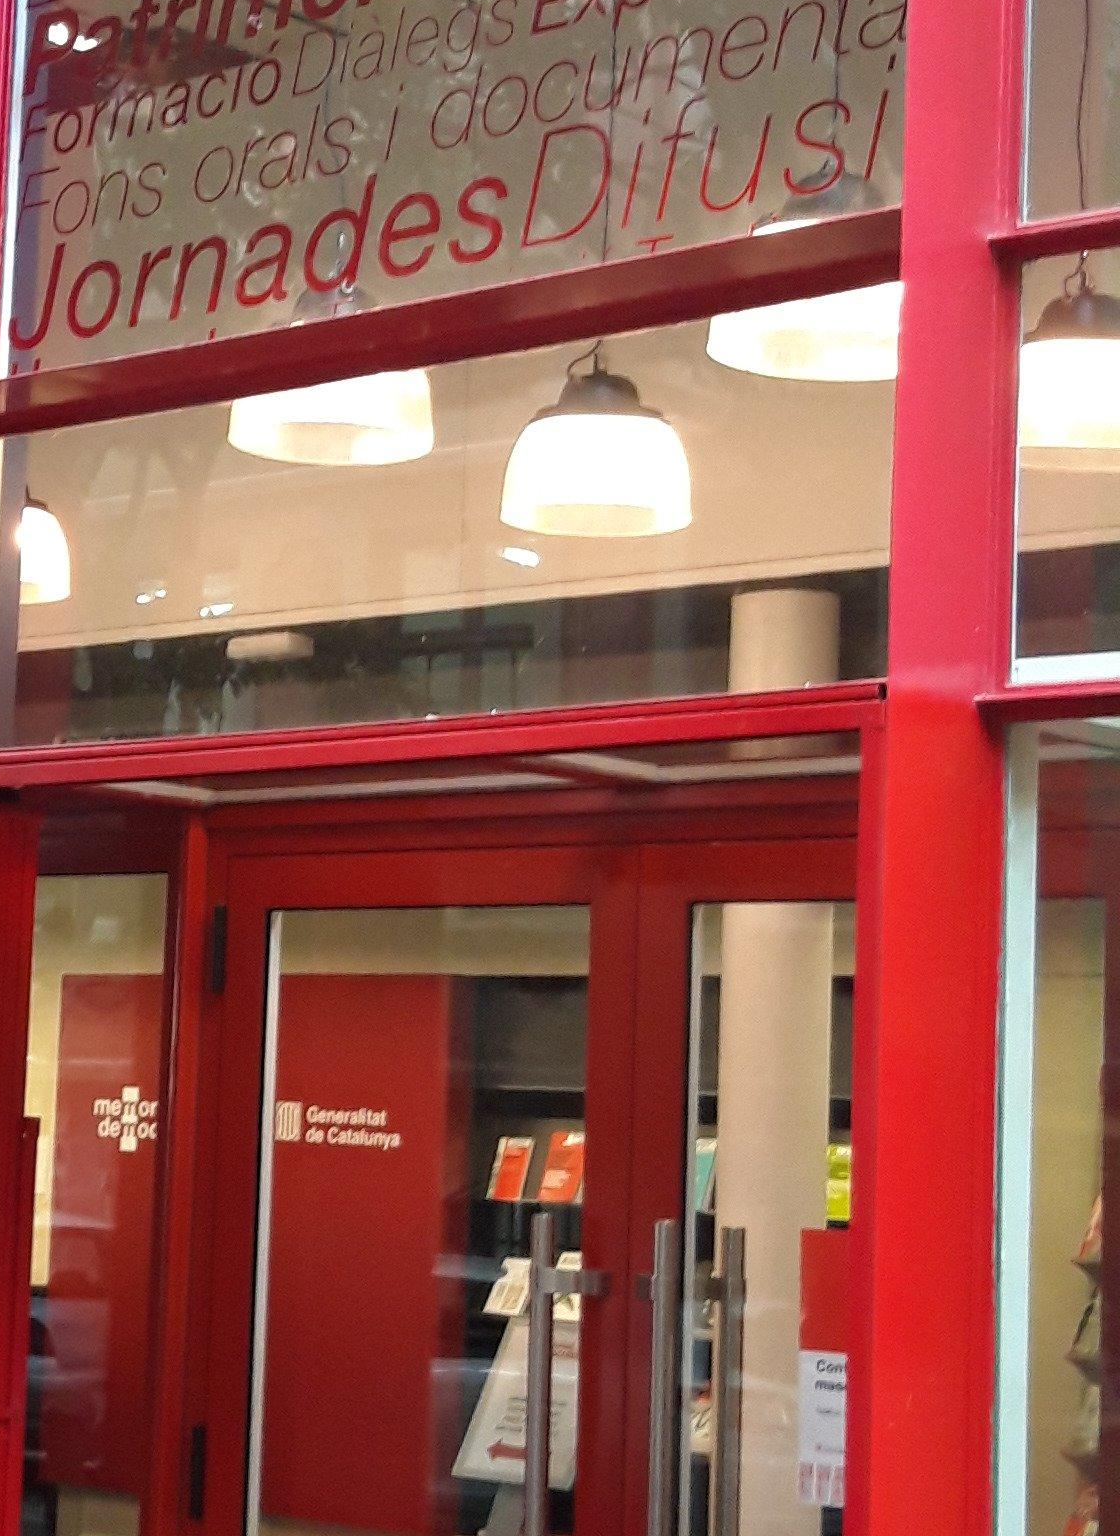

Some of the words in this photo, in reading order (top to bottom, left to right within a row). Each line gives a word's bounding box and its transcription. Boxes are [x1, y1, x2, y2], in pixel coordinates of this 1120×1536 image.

[19, 161, 167, 242] Fons
[193, 96, 355, 204] orals
[383, 84, 405, 163] i
[21, 37, 281, 163] Formació
[10, 174, 508, 352] Jornades
[519, 53, 896, 251] Difusi
[305, 1127, 325, 1143] de
[327, 1127, 402, 1152] Catalunya
[306, 1104, 388, 1127] Generalitat
